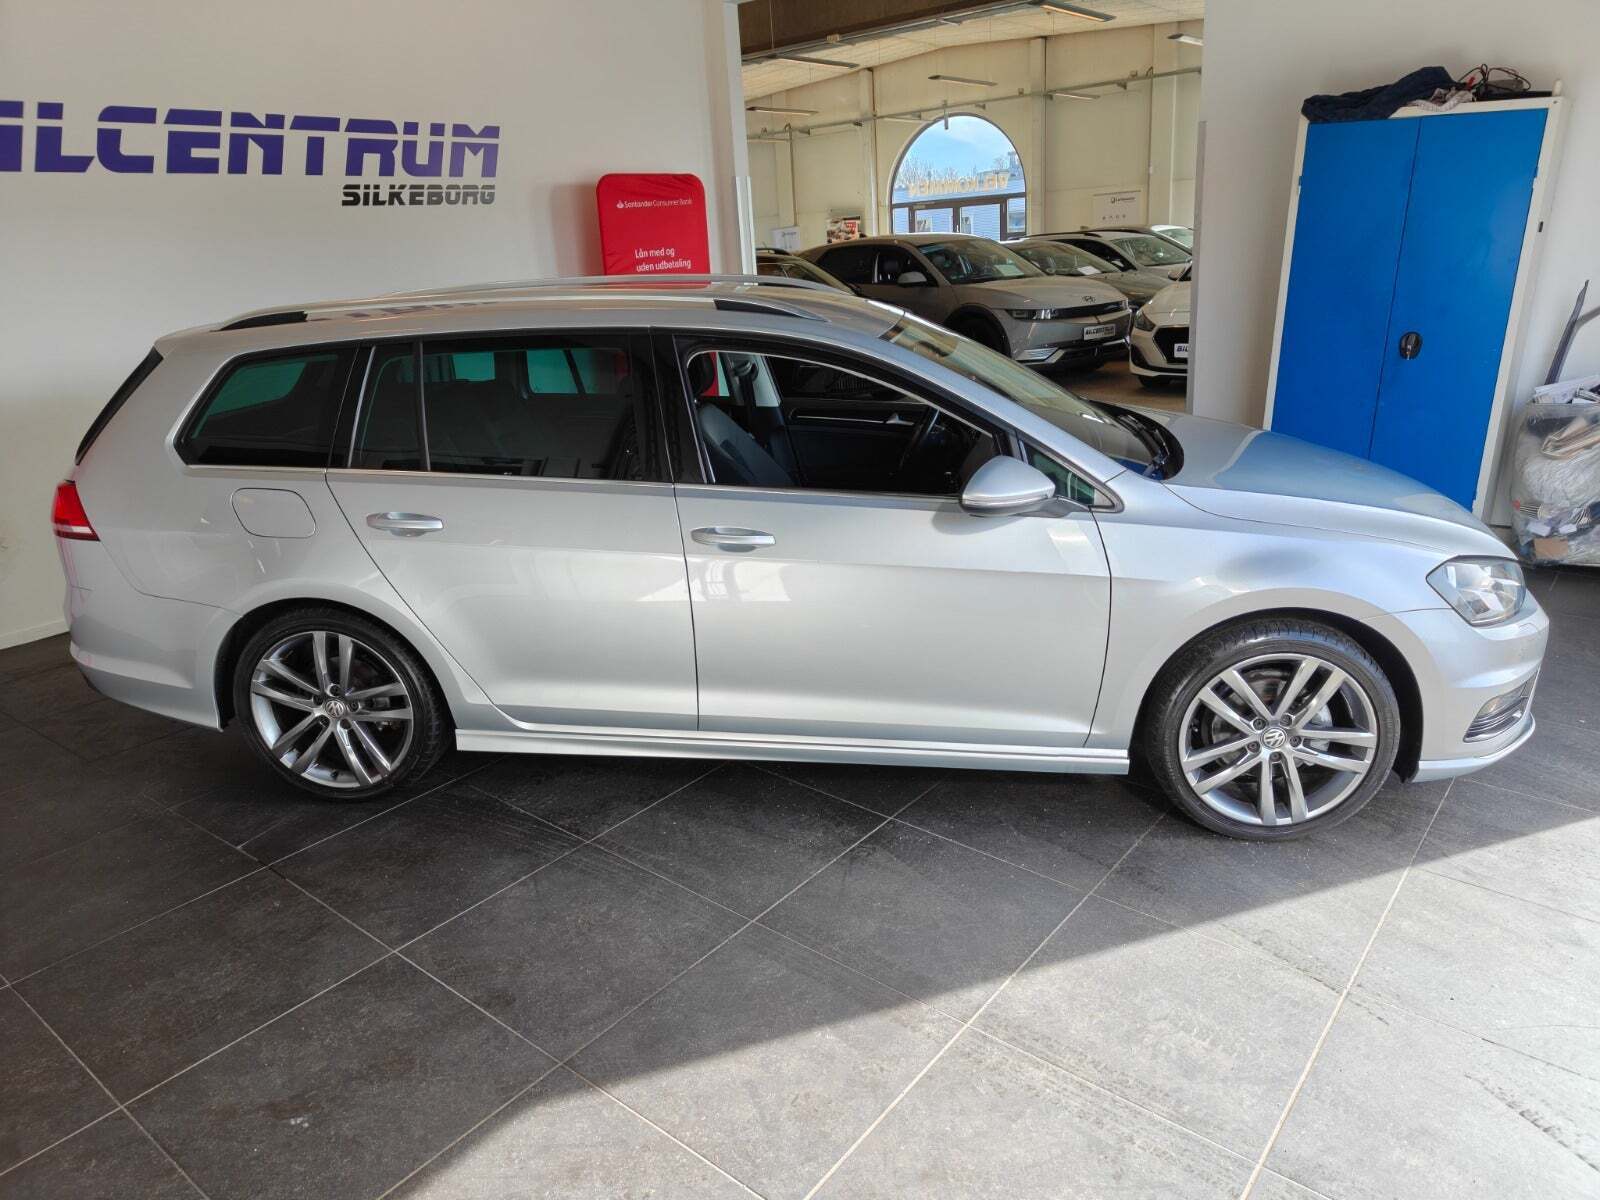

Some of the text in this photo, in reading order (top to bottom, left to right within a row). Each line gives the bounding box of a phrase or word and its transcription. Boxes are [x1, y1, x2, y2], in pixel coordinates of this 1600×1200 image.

[342, 184, 496, 206] SILKEBORG
[634, 247, 675, 259] Lån med og
[636, 259, 691, 272] uden udbetaling
